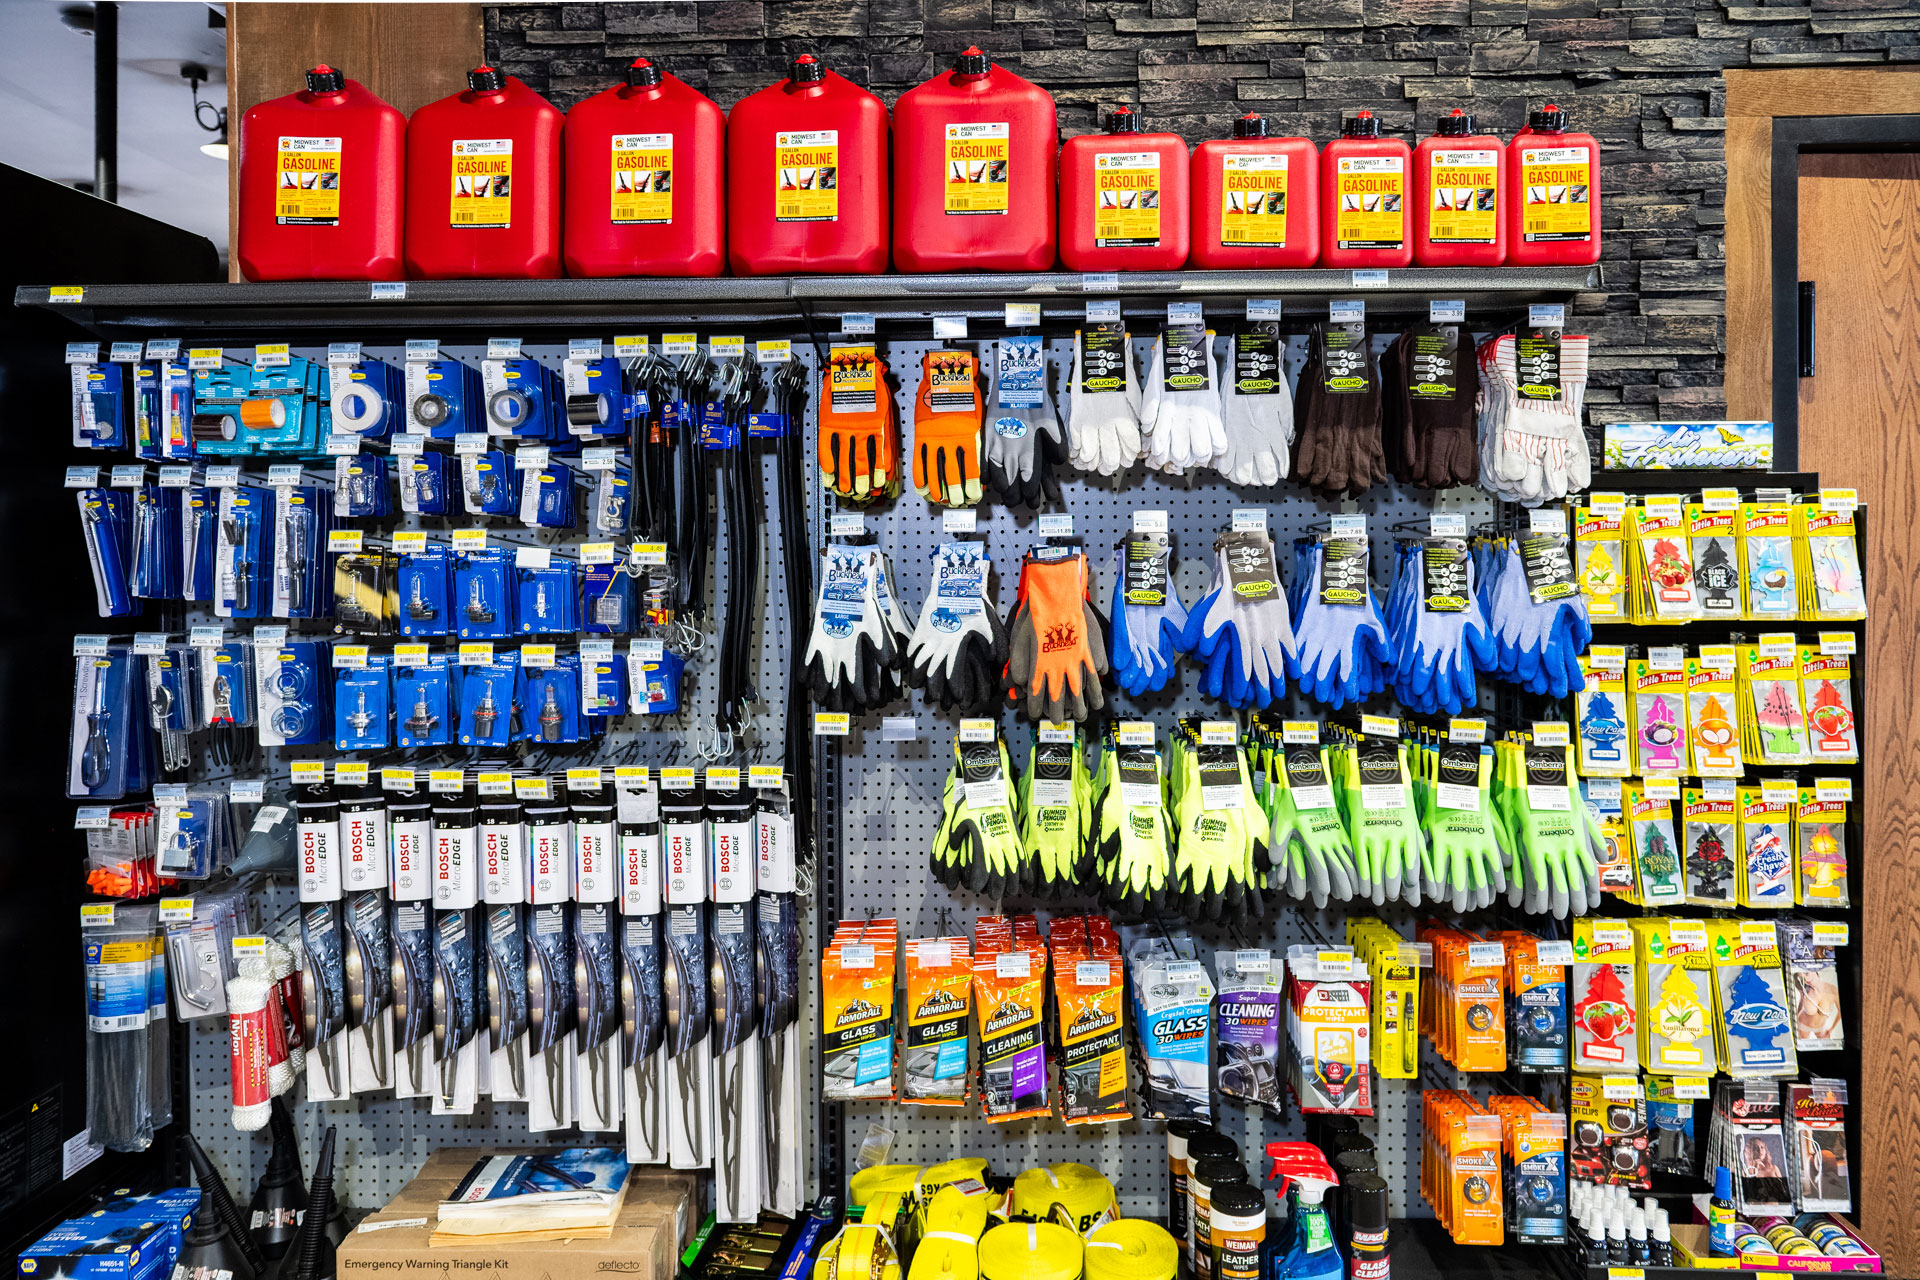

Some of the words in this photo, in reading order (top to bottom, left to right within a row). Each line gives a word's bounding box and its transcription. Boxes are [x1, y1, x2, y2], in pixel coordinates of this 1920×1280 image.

[951, 145, 1003, 158] GASOLINE
[283, 158, 335, 170] GASOLINE
[617, 156, 667, 168] GASOLINE
[782, 153, 832, 166] GASOLINE
[458, 161, 507, 173] GASOLINE
[1101, 175, 1154, 187] GASOLINE
[1229, 177, 1282, 188] GASOLINE
[1437, 173, 1491, 185] GASOLINE
[1529, 170, 1583, 183] GASOLINE
[1344, 179, 1397, 191] GASOLINE
[1001, 359, 1041, 371] Buckhead
[833, 370, 873, 383] Buckhead
[931, 373, 970, 386] Buckhead
[1090, 379, 1117, 387] GAUCHO
[1333, 379, 1361, 387] GAUCHO
[1655, 426, 1700, 449] Air
[1621, 440, 1757, 468] Fresheners
[1691, 519, 1711, 532] Little
[1713, 516, 1732, 526] Trees
[1746, 519, 1765, 532] Little
[1767, 515, 1787, 525] Trees
[829, 569, 864, 582] Buckhead
[941, 566, 980, 578] Buckhead
[1240, 583, 1270, 592] GAUCHO
[1043, 639, 1077, 653] Buckhead
[1803, 663, 1823, 674] Little
[1824, 660, 1846, 669] Trees
[1637, 677, 1658, 689] Little
[1660, 672, 1683, 682] Trees
[1288, 762, 1322, 770] Omberra
[1442, 759, 1478, 768] Omberra
[1528, 760, 1564, 768] Omberra
[1686, 805, 1708, 816] Little
[1711, 803, 1733, 812] Trees
[1800, 805, 1820, 817] Little
[1823, 802, 1842, 812] Trees
[1201, 823, 1226, 832] PENGUIN
[1202, 818, 1227, 826] SUMMER
[352, 821, 363, 861] BOSCH
[366, 820, 376, 872] MicroEDGE
[761, 824, 769, 861] BOSCH
[304, 832, 314, 873] BOSCH
[318, 832, 328, 884] MicroEDGE
[400, 835, 409, 871] BOSCH
[439, 838, 449, 879] BOSCH
[487, 834, 498, 874] BOSCH
[540, 838, 549, 874] BOSCH
[583, 836, 593, 872] BOSCH
[673, 836, 683, 874] BOSCH
[721, 835, 730, 872] BOSCH
[1757, 854, 1781, 863] Fresh
[453, 838, 461, 891] MicroEDGE
[501, 833, 509, 886] MicroEDGE
[1644, 857, 1674, 865] ROYAL
[1758, 861, 1784, 871] Shave
[629, 848, 638, 885] BOSCH
[1650, 863, 1673, 872] PINE
[1393, 968, 1411, 976] GONE
[1485, 978, 1499, 993] X
[1546, 988, 1559, 1002] X
[1161, 1011, 1185, 1019] Crystal
[1220, 1003, 1275, 1017] CLEANING
[1303, 1008, 1366, 1017] PROTECTANT
[1731, 1009, 1759, 1023] New
[1762, 1009, 1788, 1023] Car
[922, 1021, 958, 1036] GLASS
[1154, 1016, 1208, 1035] GLASS
[1224, 1018, 1239, 1026] 30
[1240, 1018, 1268, 1026] WIPES
[1663, 1024, 1700, 1032] Vanillaroma
[231, 1019, 239, 1056] Nylon
[841, 1024, 876, 1040] GLASS
[1157, 1035, 1174, 1045] 30
[1174, 1030, 1204, 1040] WIPES
[987, 1031, 1033, 1055] CLEANING
[1019, 1040, 1034, 1048] WIPES
[1067, 1034, 1119, 1058] PROTECTANT
[1583, 1109, 1599, 1117] CLIPS
[1225, 1240, 1255, 1250] WEIMAN
[1222, 1253, 1258, 1263] LEATHER
[1744, 1255, 1754, 1263] 8X
[1787, 1260, 1832, 1268] CALIFORNIA
[344, 1259, 403, 1271] Emergency
[406, 1259, 449, 1271] Warning
[451, 1259, 491, 1271] Triangle
[494, 1259, 509, 1269] Kit
[598, 1260, 640, 1270] deflecto
[1360, 1261, 1387, 1270] GLASS
